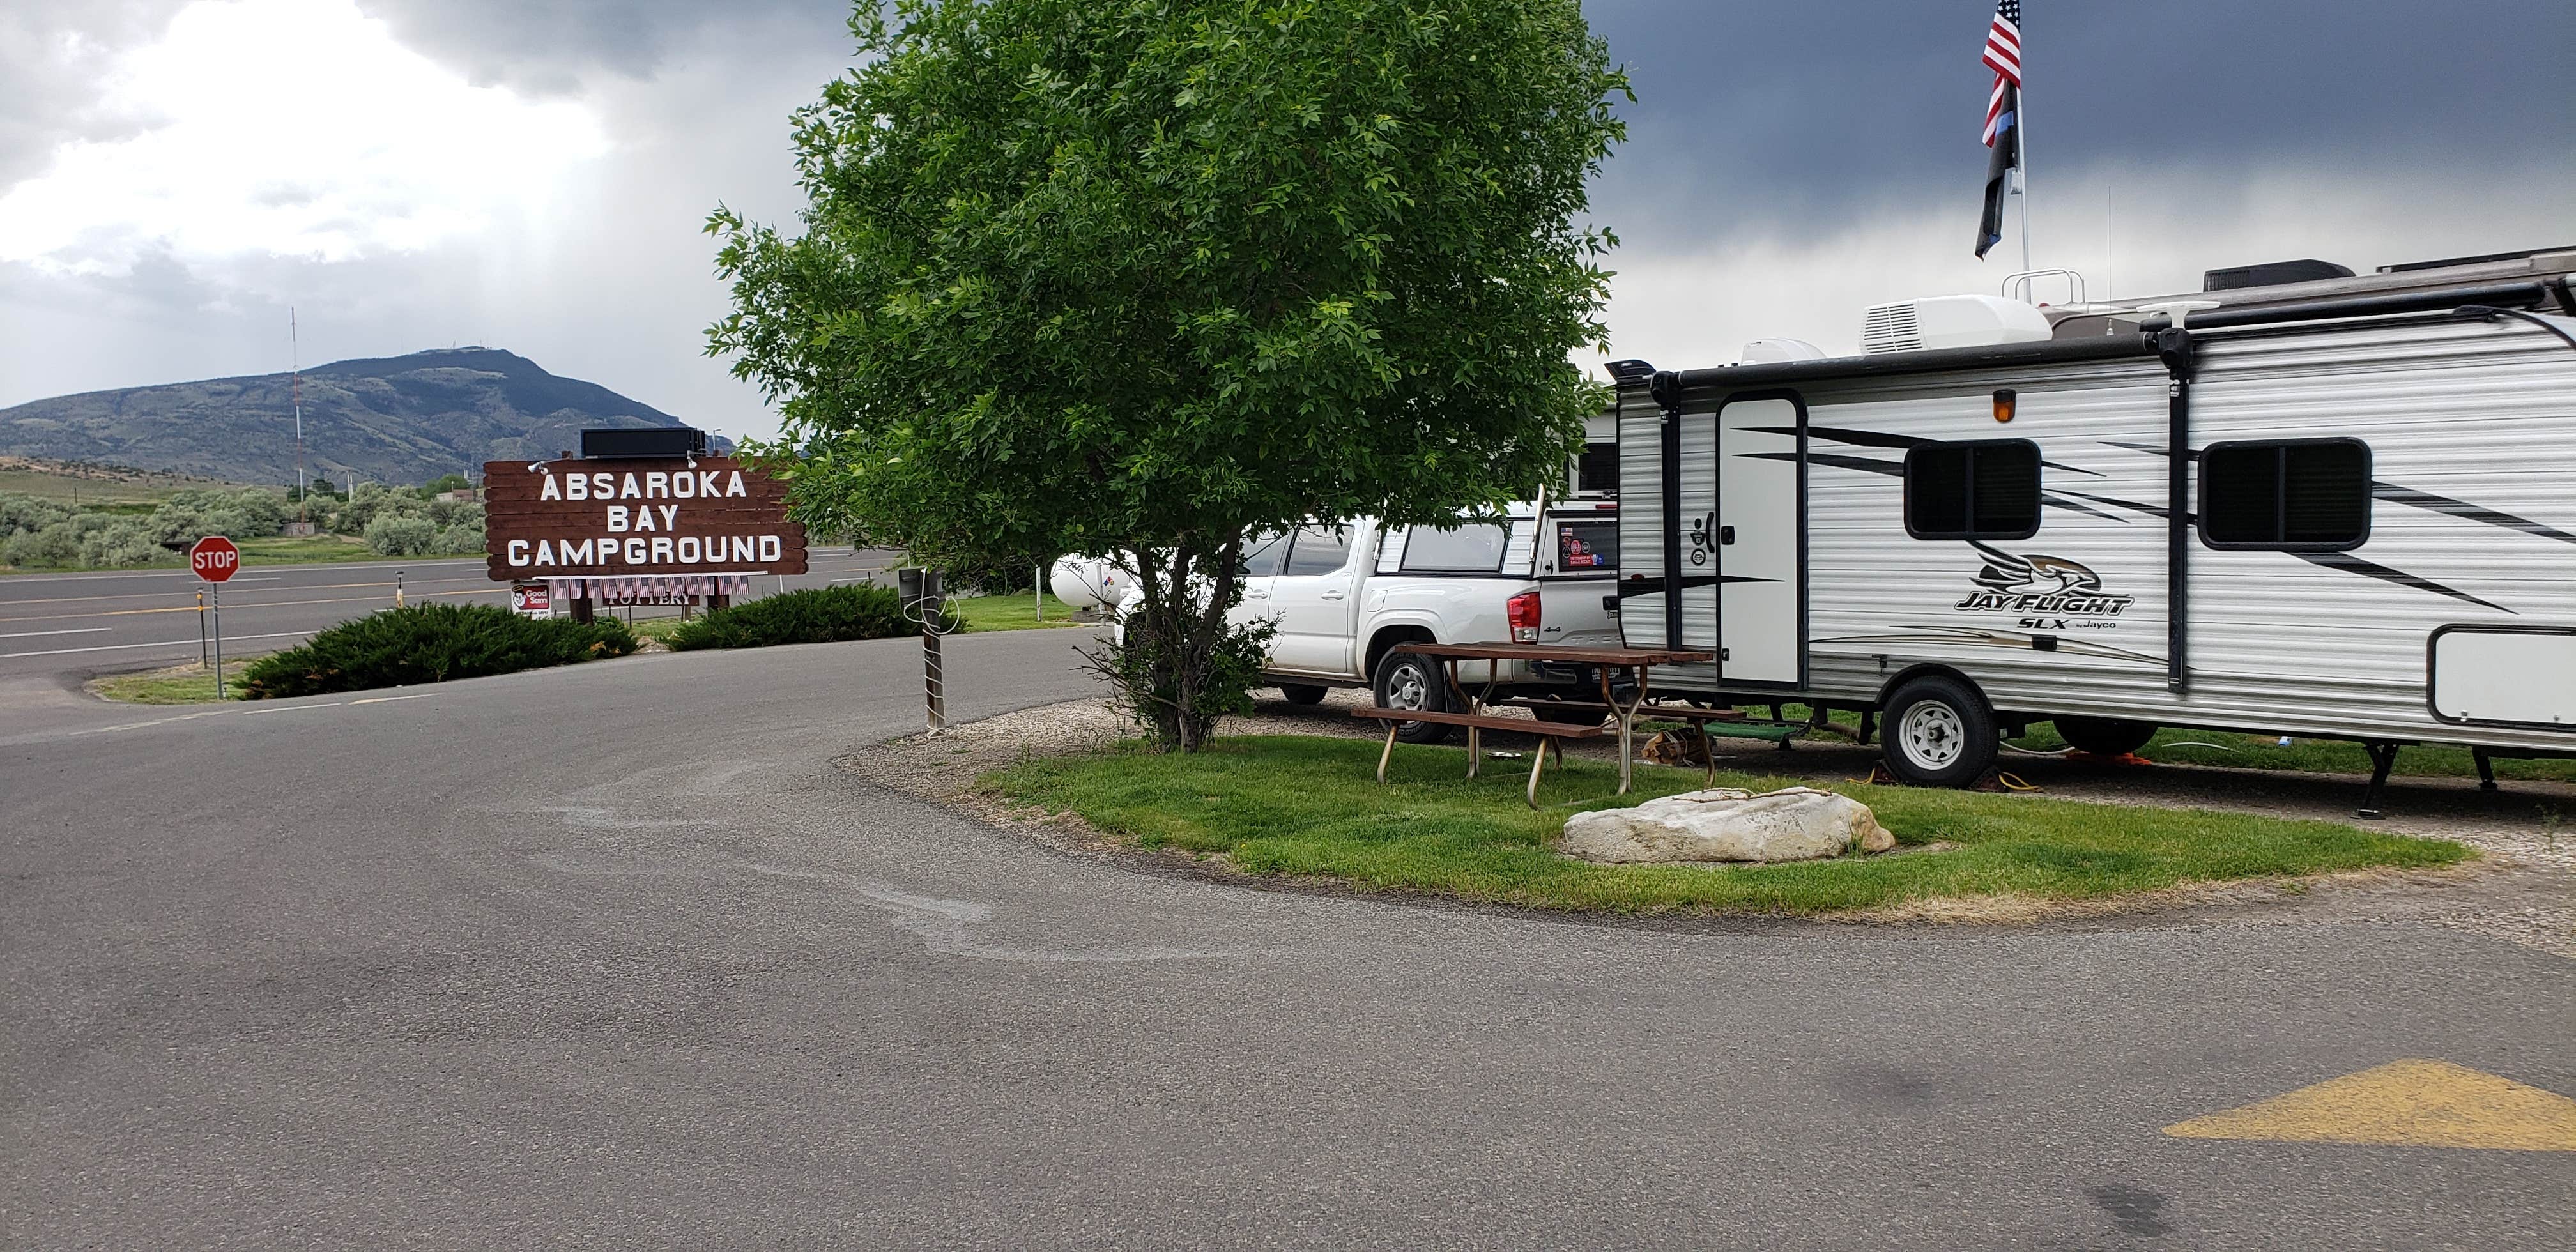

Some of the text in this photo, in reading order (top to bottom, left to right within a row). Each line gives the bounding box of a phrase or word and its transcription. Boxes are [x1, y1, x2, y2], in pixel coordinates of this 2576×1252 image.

[540, 471, 746, 501] ABSAROKA
[607, 504, 678, 532] BAY
[195, 551, 236, 569] STOP
[507, 535, 781, 566] CAMPGROUND
[1956, 592, 2133, 614] JAY FLIGHT
[2017, 618, 2071, 629] SLX
[2083, 620, 2116, 629] Jayco
